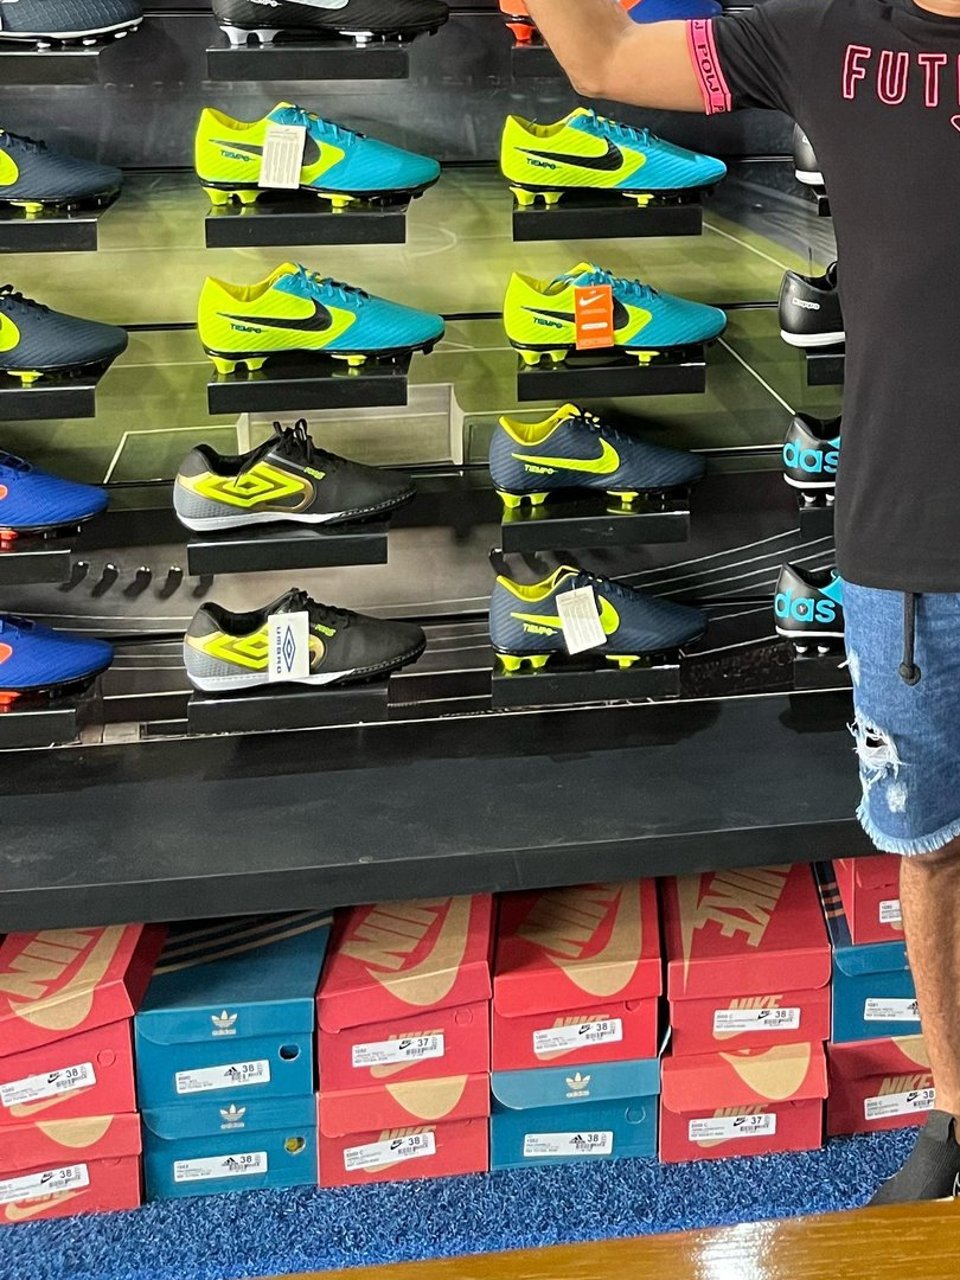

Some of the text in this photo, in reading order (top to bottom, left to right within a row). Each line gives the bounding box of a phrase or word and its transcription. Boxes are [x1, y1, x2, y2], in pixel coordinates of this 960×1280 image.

[783, 438, 839, 473] das
[775, 587, 836, 623] das
[775, 1010, 787, 1018] 38
[596, 1023, 608, 1031] 38
[417, 1038, 429, 1047] 37
[66, 1068, 79, 1078] 38
[242, 1064, 255, 1073] 38
[923, 1091, 935, 1099] 38
[751, 1116, 762, 1125] 37
[408, 1137, 421, 1146] 38
[587, 1134, 599, 1143] 38
[240, 1156, 252, 1164] 38
[60, 1169, 72, 1178] 38
